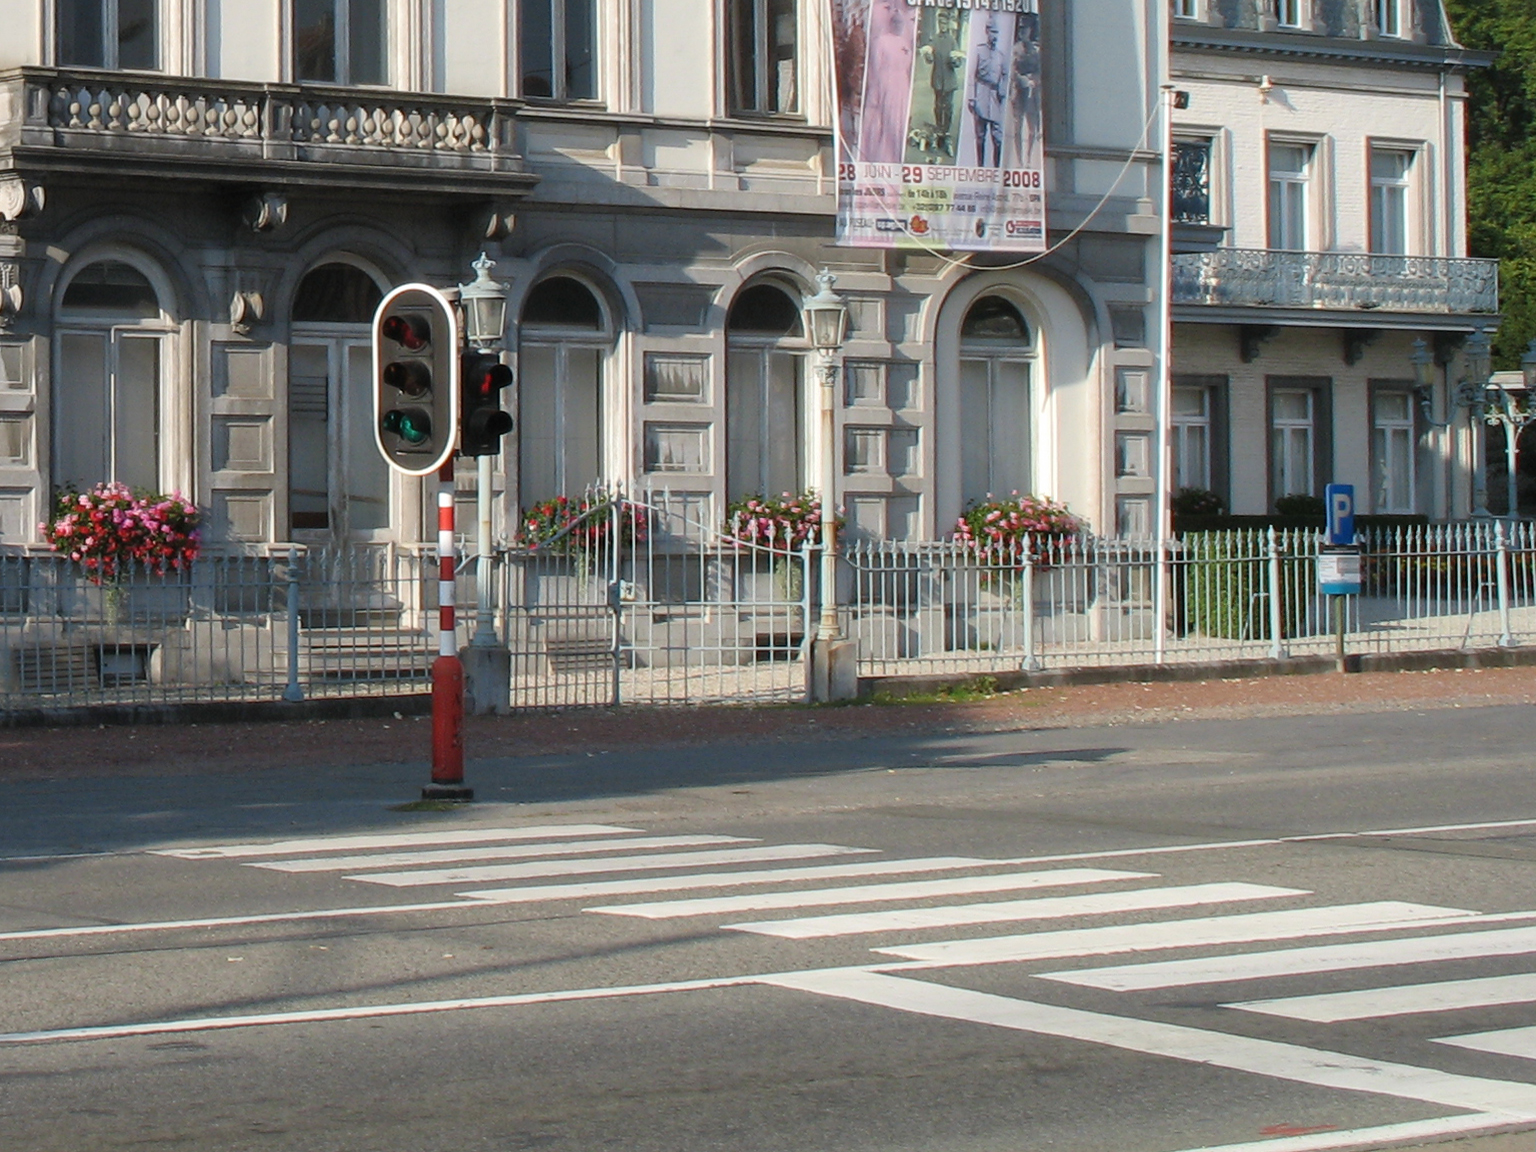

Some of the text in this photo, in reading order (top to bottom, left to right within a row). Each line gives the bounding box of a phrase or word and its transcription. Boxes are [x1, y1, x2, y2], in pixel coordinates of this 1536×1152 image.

[838, 163, 856, 181] 28
[864, 164, 892, 179] JUIN
[901, 166, 923, 184] 29
[927, 166, 1000, 183] SEPTEMBRE
[1003, 170, 1041, 188] 2008
[1333, 493, 1351, 535] P
